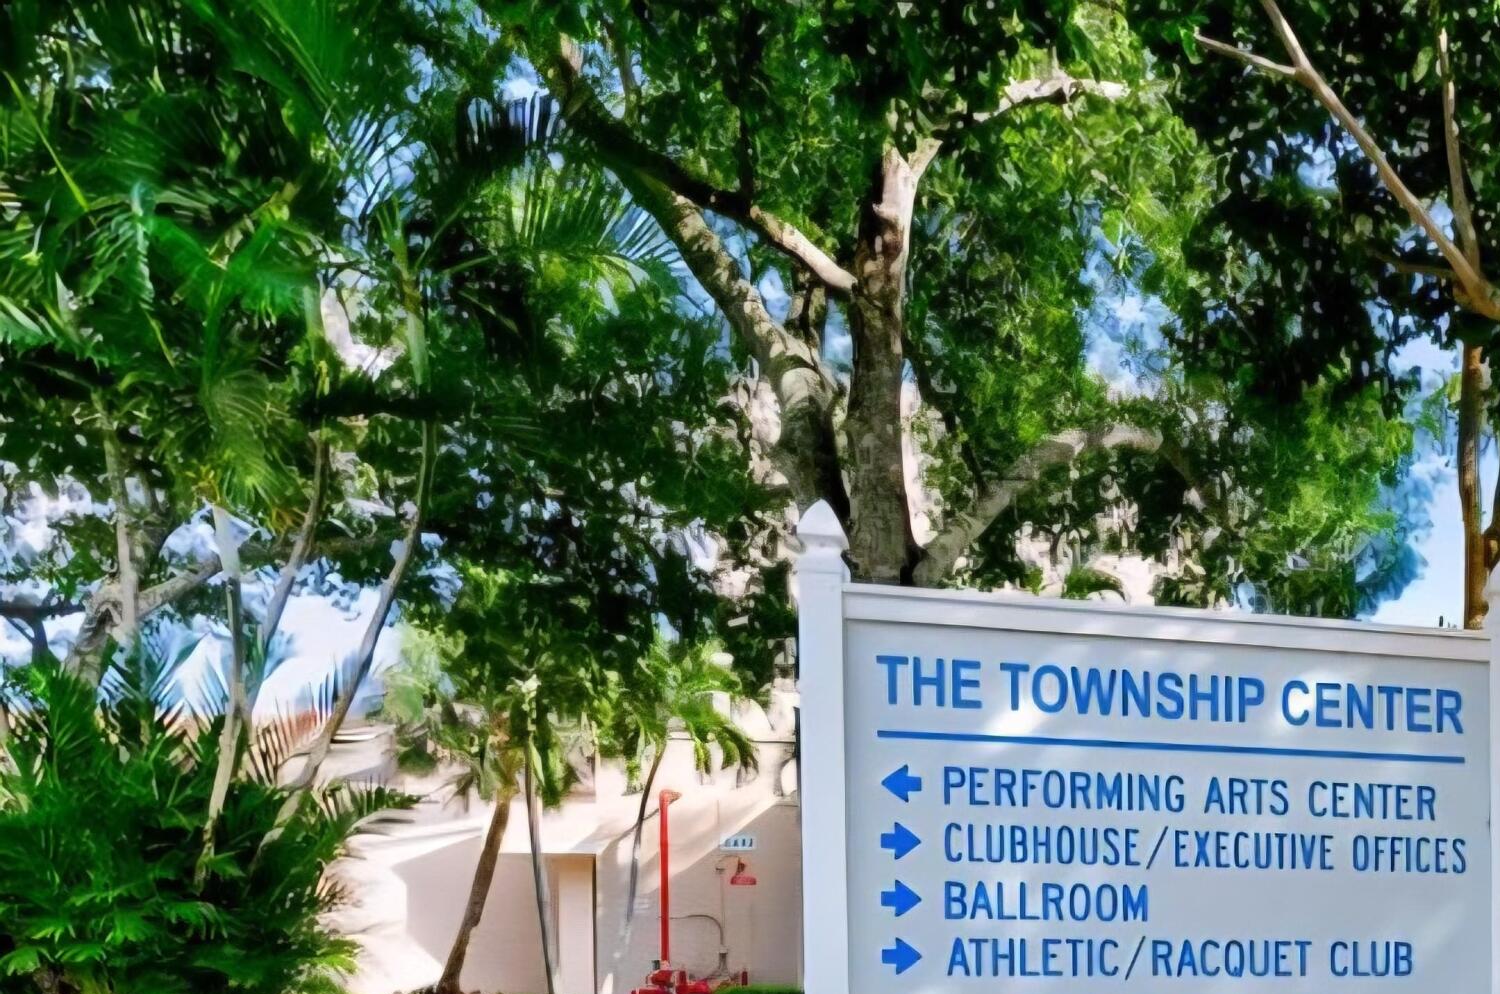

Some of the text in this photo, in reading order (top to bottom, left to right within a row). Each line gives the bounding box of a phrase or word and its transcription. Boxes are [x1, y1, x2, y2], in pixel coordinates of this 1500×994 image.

[875, 655, 1464, 735] THE TOWNSHIP CENTER
[943, 766, 1436, 821] PERFORMING ARTS CENTER
[944, 822, 1467, 874] CLUBHOUSE/EXECUTIVE OFFICES
[944, 880, 1149, 922] BALLROOM
[947, 935, 1413, 980] ATHLETIC/RACQUET CLUB
